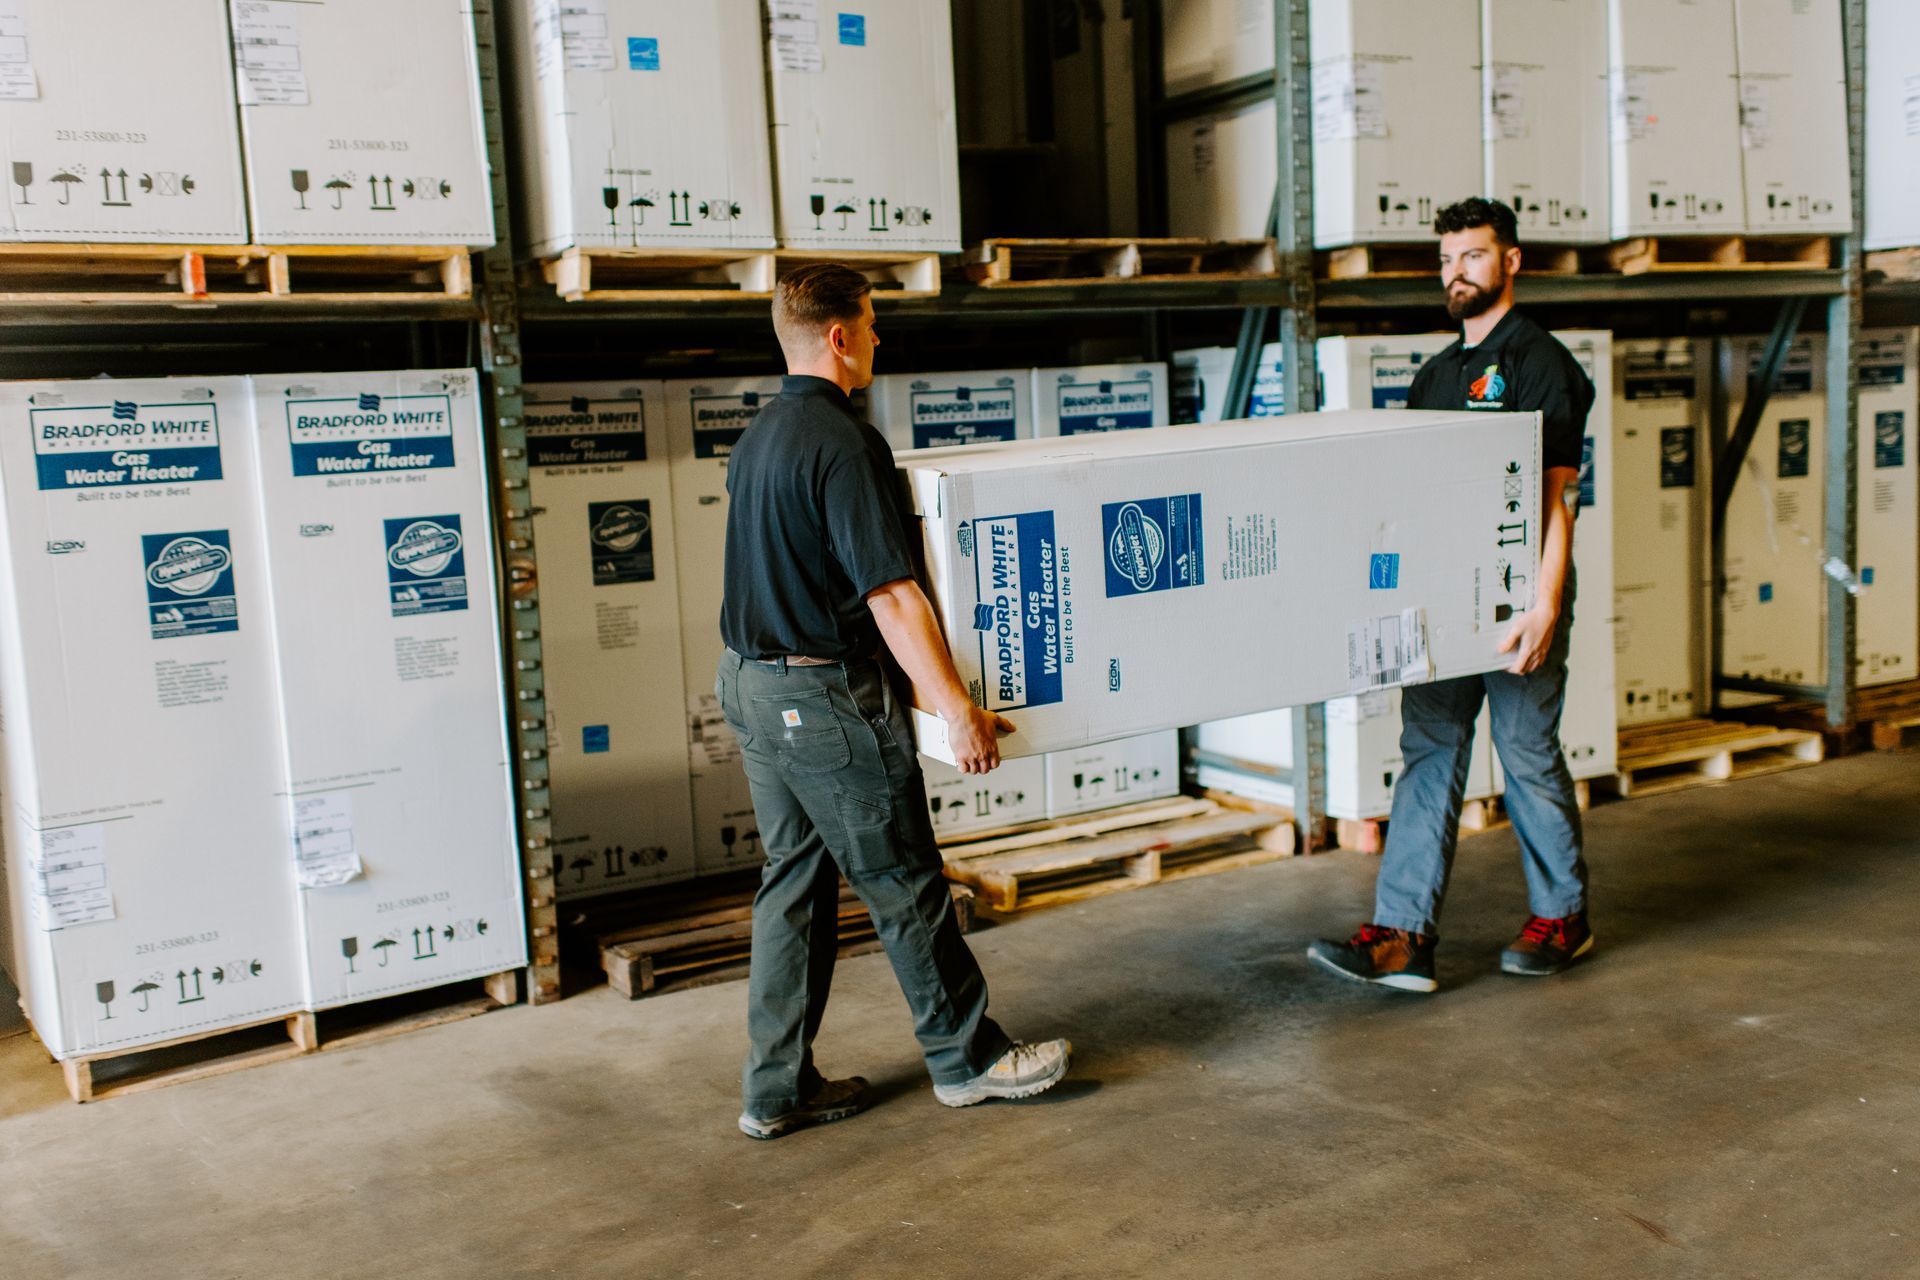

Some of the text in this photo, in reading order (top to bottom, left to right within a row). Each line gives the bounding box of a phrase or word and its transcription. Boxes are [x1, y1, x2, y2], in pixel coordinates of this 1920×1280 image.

[917, 400, 1009, 414] BRADFORD WHITE
[1063, 394, 1115, 406] BRADFORD
[297, 411, 444, 429] BRADFORD WHITE
[524, 412, 639, 426] BRADFORD WHITE
[43, 420, 210, 439] BRADFORD WHITE
[302, 429, 356, 437] WATER
[955, 424, 976, 435] Gas
[49, 435, 207, 447] WATER HEATERS
[358, 440, 391, 455] Gas
[571, 438, 596, 450] Gas
[112, 451, 150, 466] Gas
[317, 453, 434, 472] Water Heater
[539, 449, 629, 462] Water Heater
[65, 465, 199, 485] Water Heater
[385, 475, 402, 484] the
[405, 473, 427, 483] Best
[77, 486, 191, 502] Built to be the Best
[47, 539, 86, 554] ICON
[1007, 529, 1022, 693] WATER HEATERS
[1026, 591, 1041, 629] Gas
[1040, 538, 1058, 674] Water Heater
[1060, 546, 1074, 663] Built to be the Best
[991, 524, 1014, 702] BRADFORD WHITE
[1109, 658, 1120, 692] ICON
